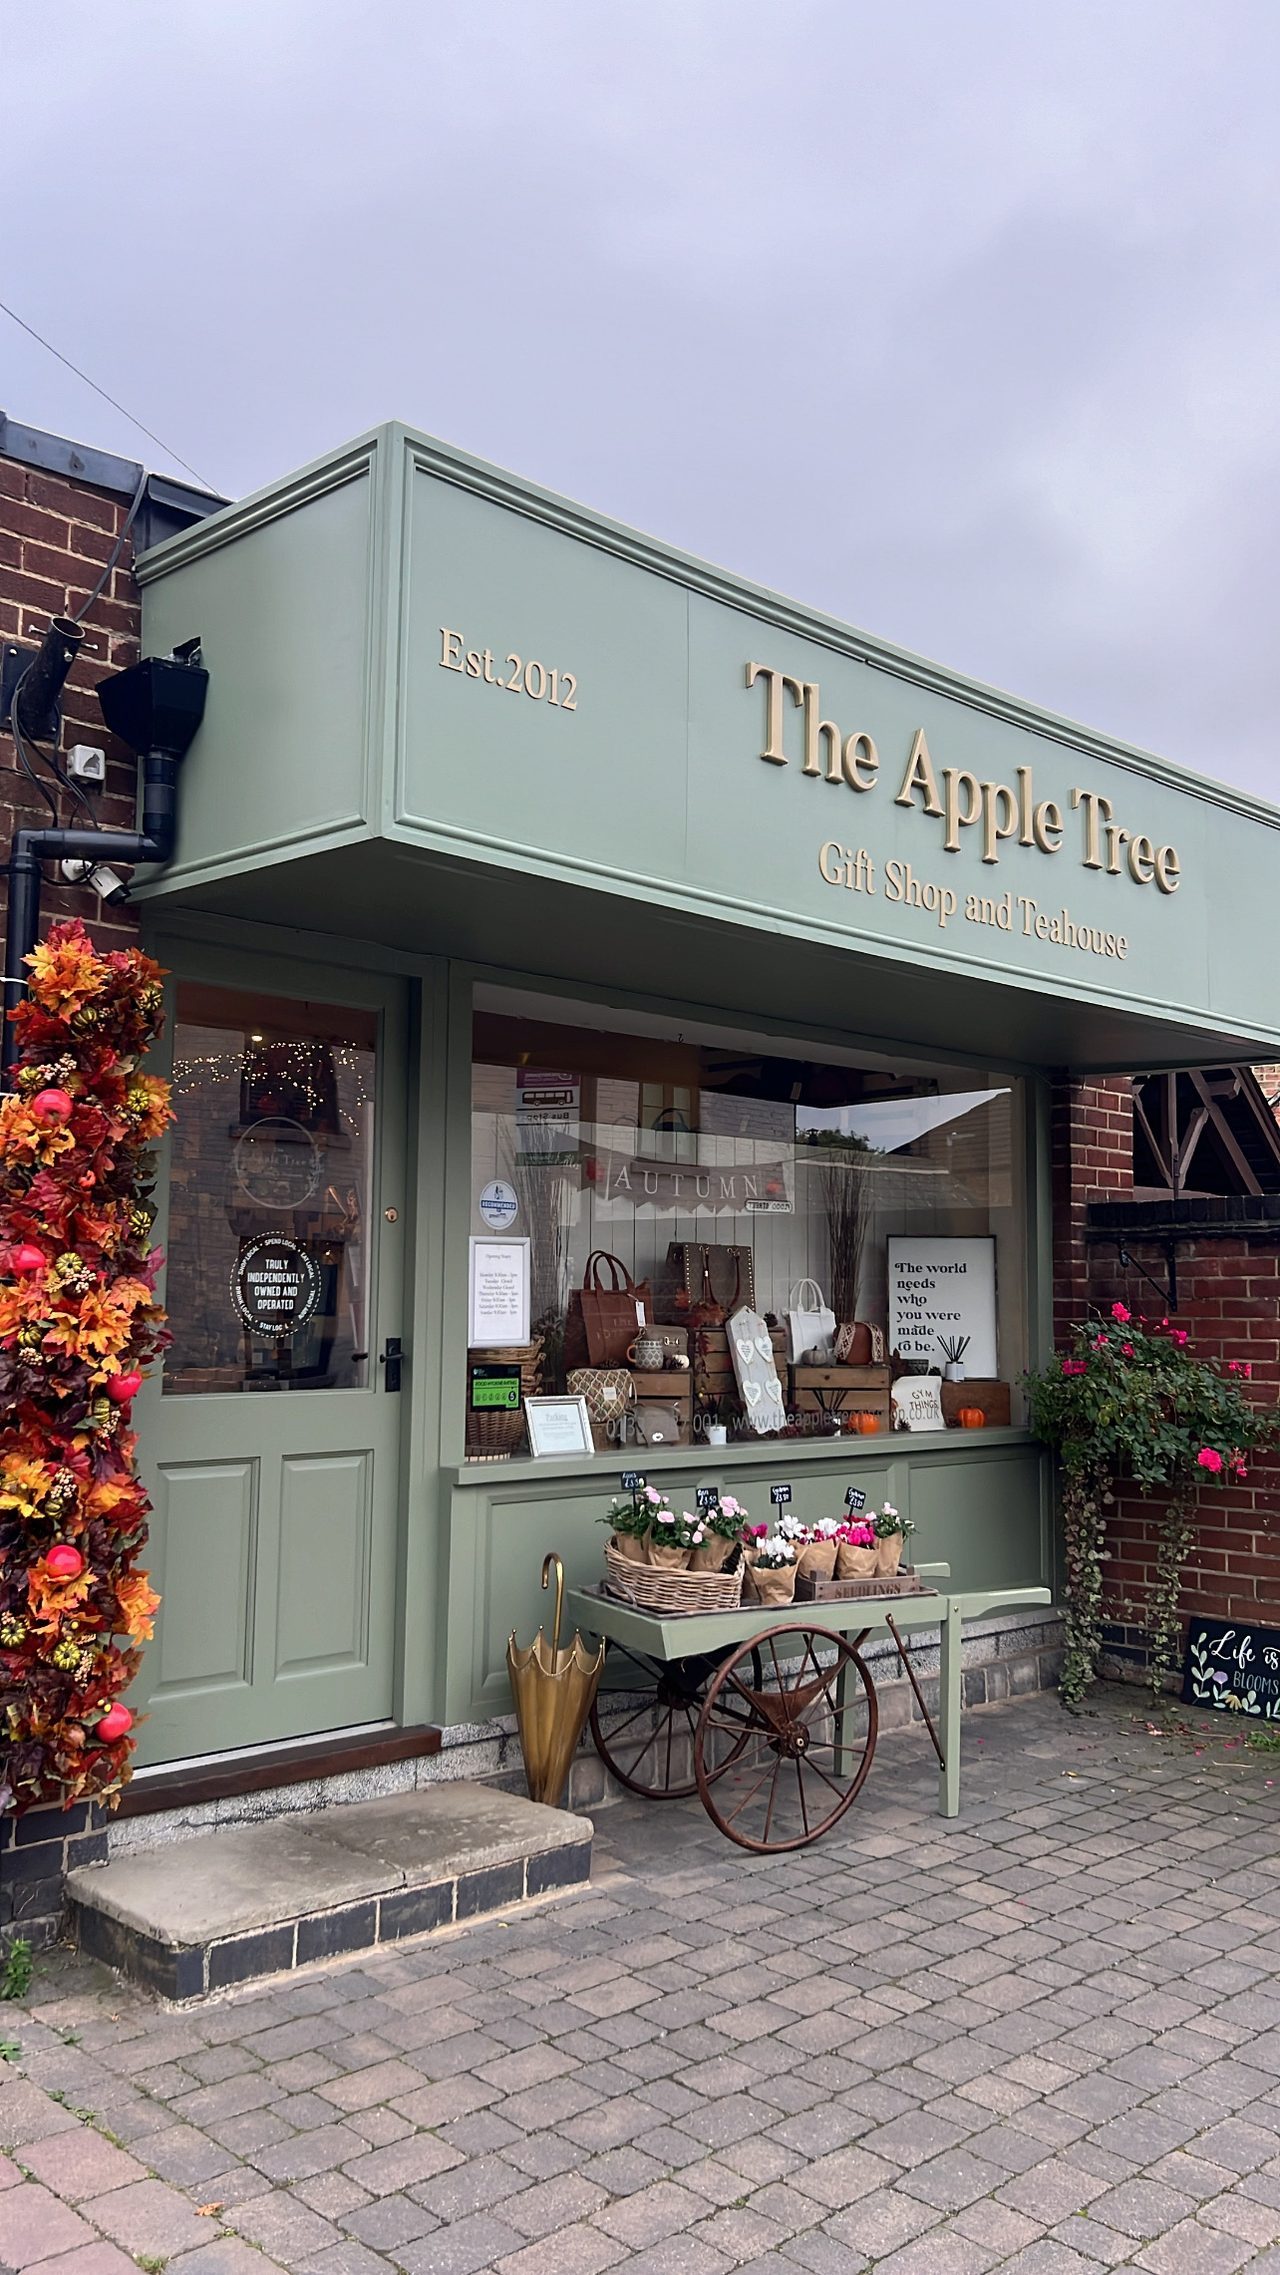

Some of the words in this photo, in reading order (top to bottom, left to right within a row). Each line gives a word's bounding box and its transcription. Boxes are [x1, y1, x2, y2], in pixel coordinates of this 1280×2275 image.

[438, 626, 577, 712] Est.2012
[744, 661, 879, 793] The
[894, 728, 1065, 865] Apple
[1071, 787, 1181, 894] Tree
[818, 841, 878, 896] Gift
[883, 859, 957, 928] Shop
[965, 892, 1013, 931] and
[1016, 897, 1129, 961] Teahouse
[614, 1166, 758, 1199] AUTUMN
[264, 1238, 281, 1246] SPEND
[281, 1239, 297, 1250] LOCAL
[238, 1260, 249, 1276] SHOP
[245, 1245, 260, 1261] LOCAL
[265, 1259, 289, 1270] TRULY
[300, 1252, 310, 1263] EAT
[305, 1262, 315, 1279] LOCAL
[894, 1262, 923, 1273] The
[926, 1262, 967, 1273] world
[247, 1272, 305, 1283] INDEPENDENTLY
[897, 1278, 936, 1291] needs
[254, 1286, 280, 1296] OWNED
[282, 1286, 298, 1297] AND
[235, 1286, 244, 1305] DRINK
[240, 1304, 254, 1321] LOCAL
[257, 1299, 294, 1310] OPERATED
[307, 1290, 316, 1308] LOCAL
[897, 1293, 928, 1307] who
[896, 1311, 922, 1323] you
[925, 1312, 961, 1321] were
[259, 1322, 272, 1331] STAY
[272, 1323, 288, 1331] LOCL
[897, 1324, 935, 1336] made
[897, 1340, 912, 1351] to
[915, 1340, 935, 1352] be.
[911, 1389, 933, 1400] GYM
[909, 1400, 939, 1411] THINGS
[1208, 1630, 1256, 1669] Life
[1233, 1670, 1279, 1695] BLOOMS
